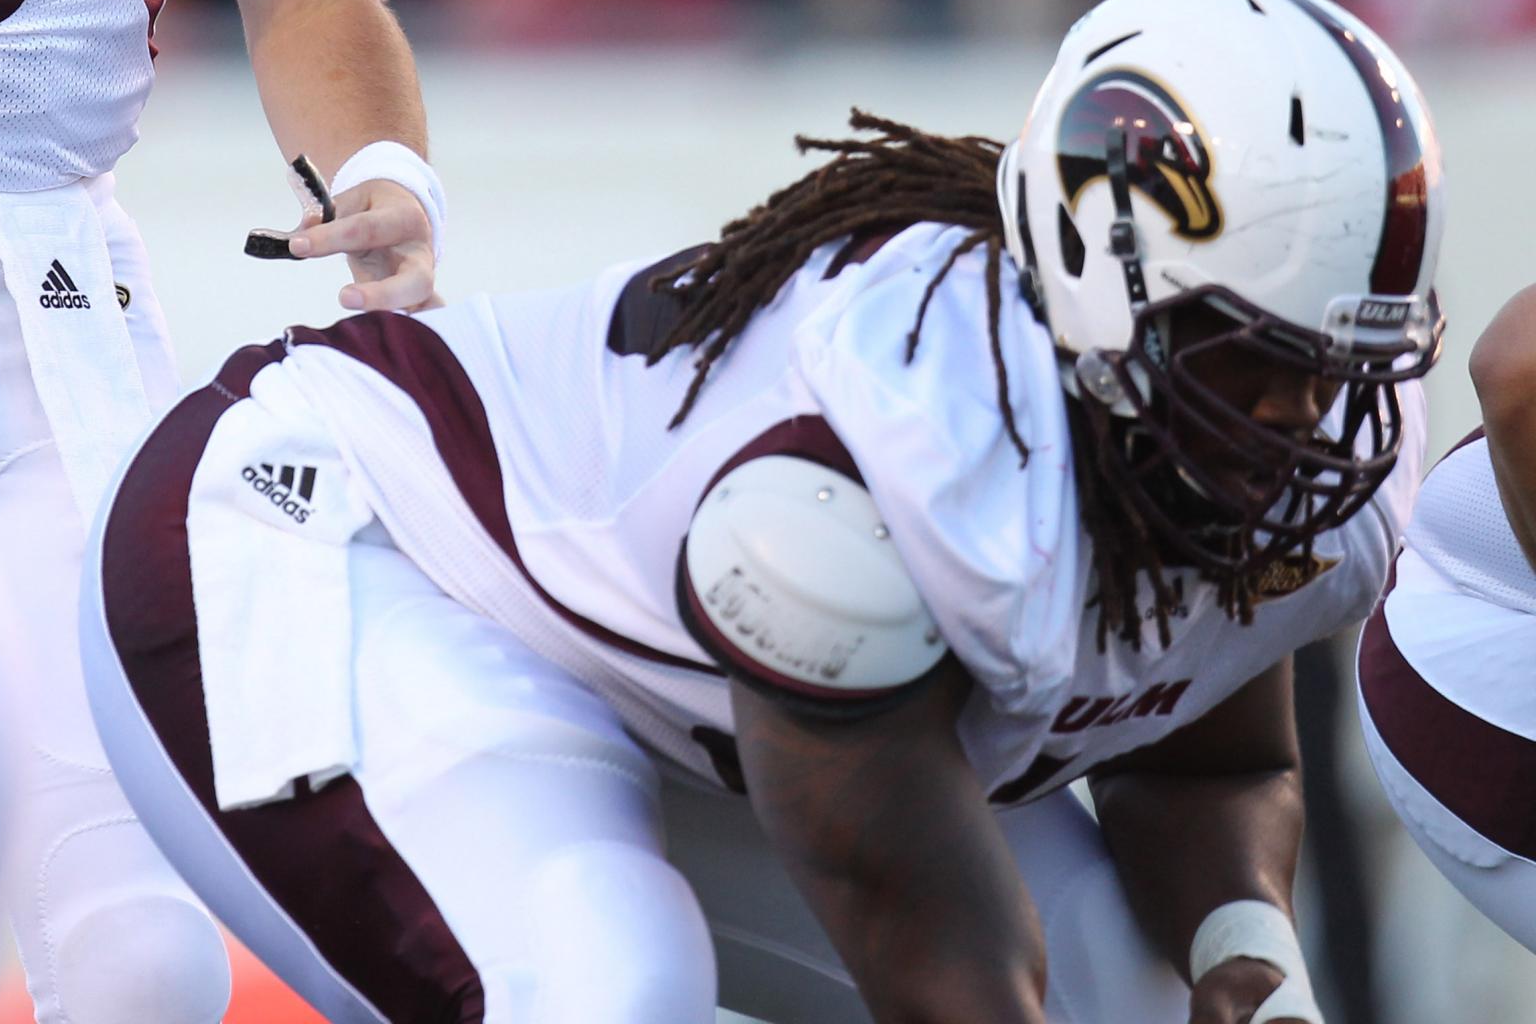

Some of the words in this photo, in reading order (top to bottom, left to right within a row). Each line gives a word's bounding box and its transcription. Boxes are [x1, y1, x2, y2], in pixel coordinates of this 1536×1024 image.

[38, 290, 91, 309] adidas
[241, 466, 310, 524] adidas
[1048, 678, 1193, 734] ULM
